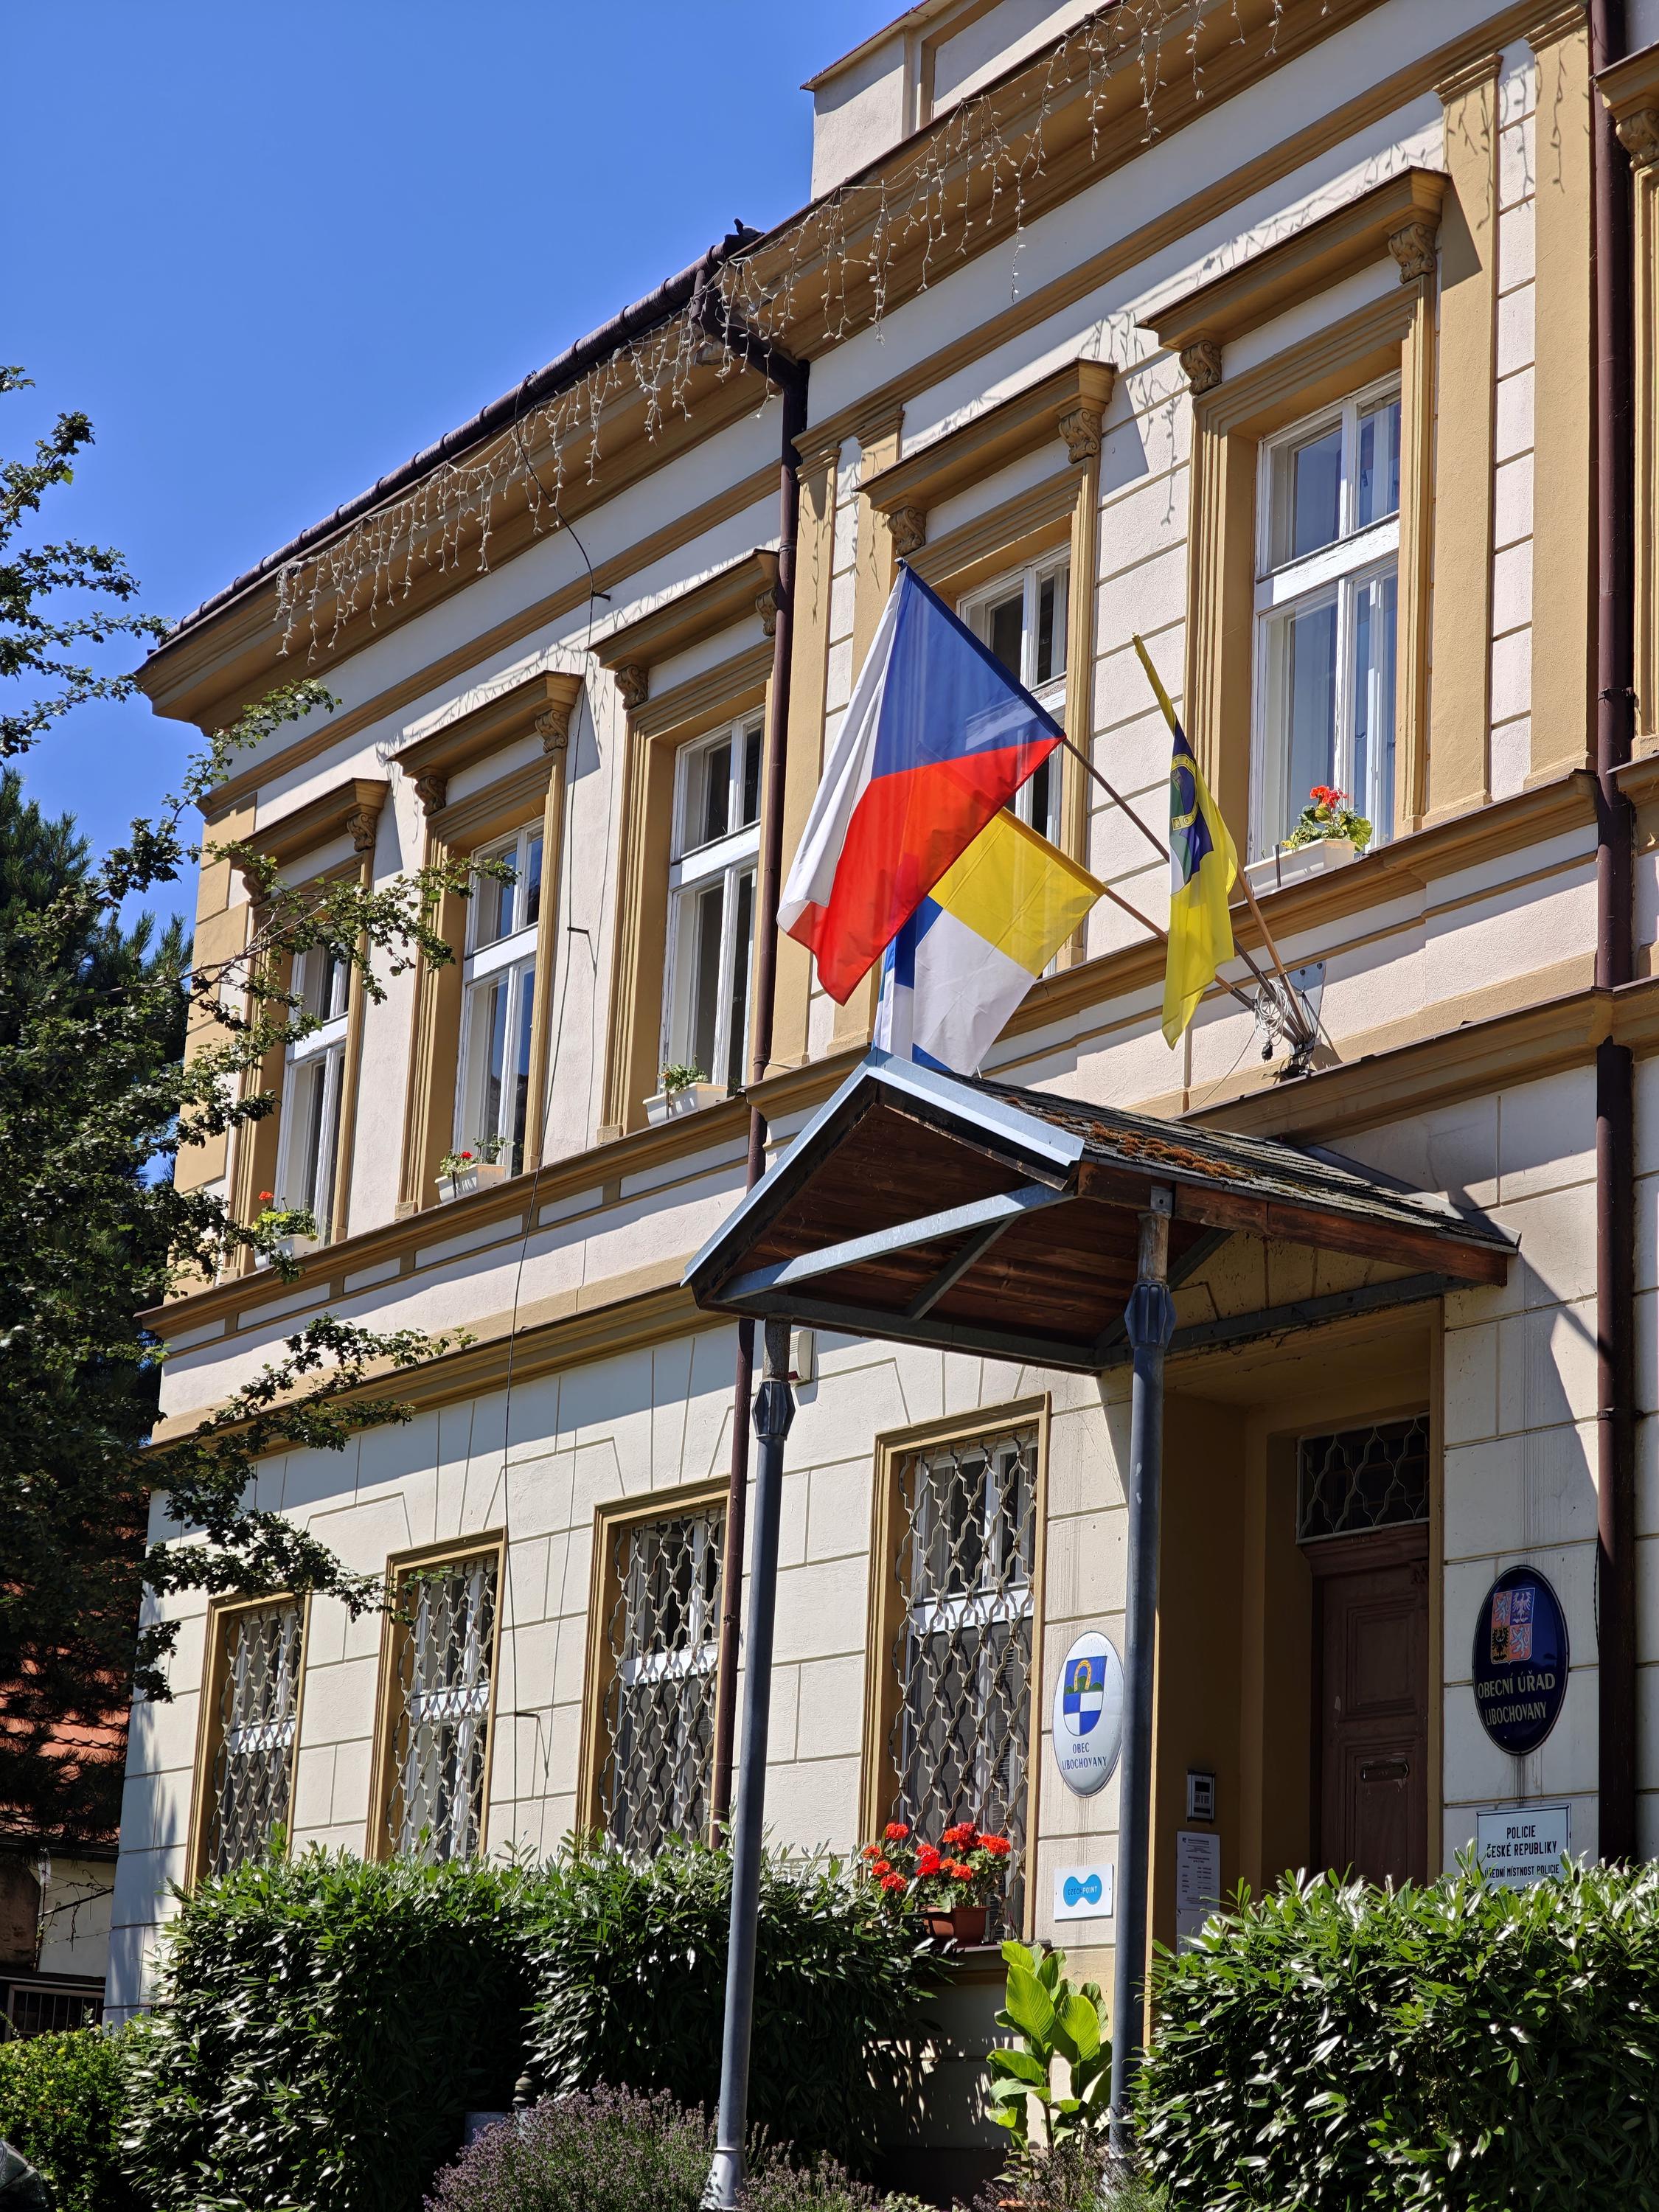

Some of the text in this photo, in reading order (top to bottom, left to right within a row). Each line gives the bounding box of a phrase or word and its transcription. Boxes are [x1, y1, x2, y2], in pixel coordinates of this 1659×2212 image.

[1478, 1670, 1556, 1699] OBECNÍ ÚŘAD
[1485, 1701, 1546, 1726] LIBOCHOVANY
[1072, 1742, 1090, 1754] OBEC
[1062, 1756, 1107, 1770] LIBOCHOVANY
[1506, 1825, 1536, 1840] POLICIE
[1486, 1840, 1557, 1858] ČESKÉ REPUBLIKY
[1506, 1865, 1534, 1877] MÍSTNOST
[1537, 1864, 1559, 1874] POLICIE
